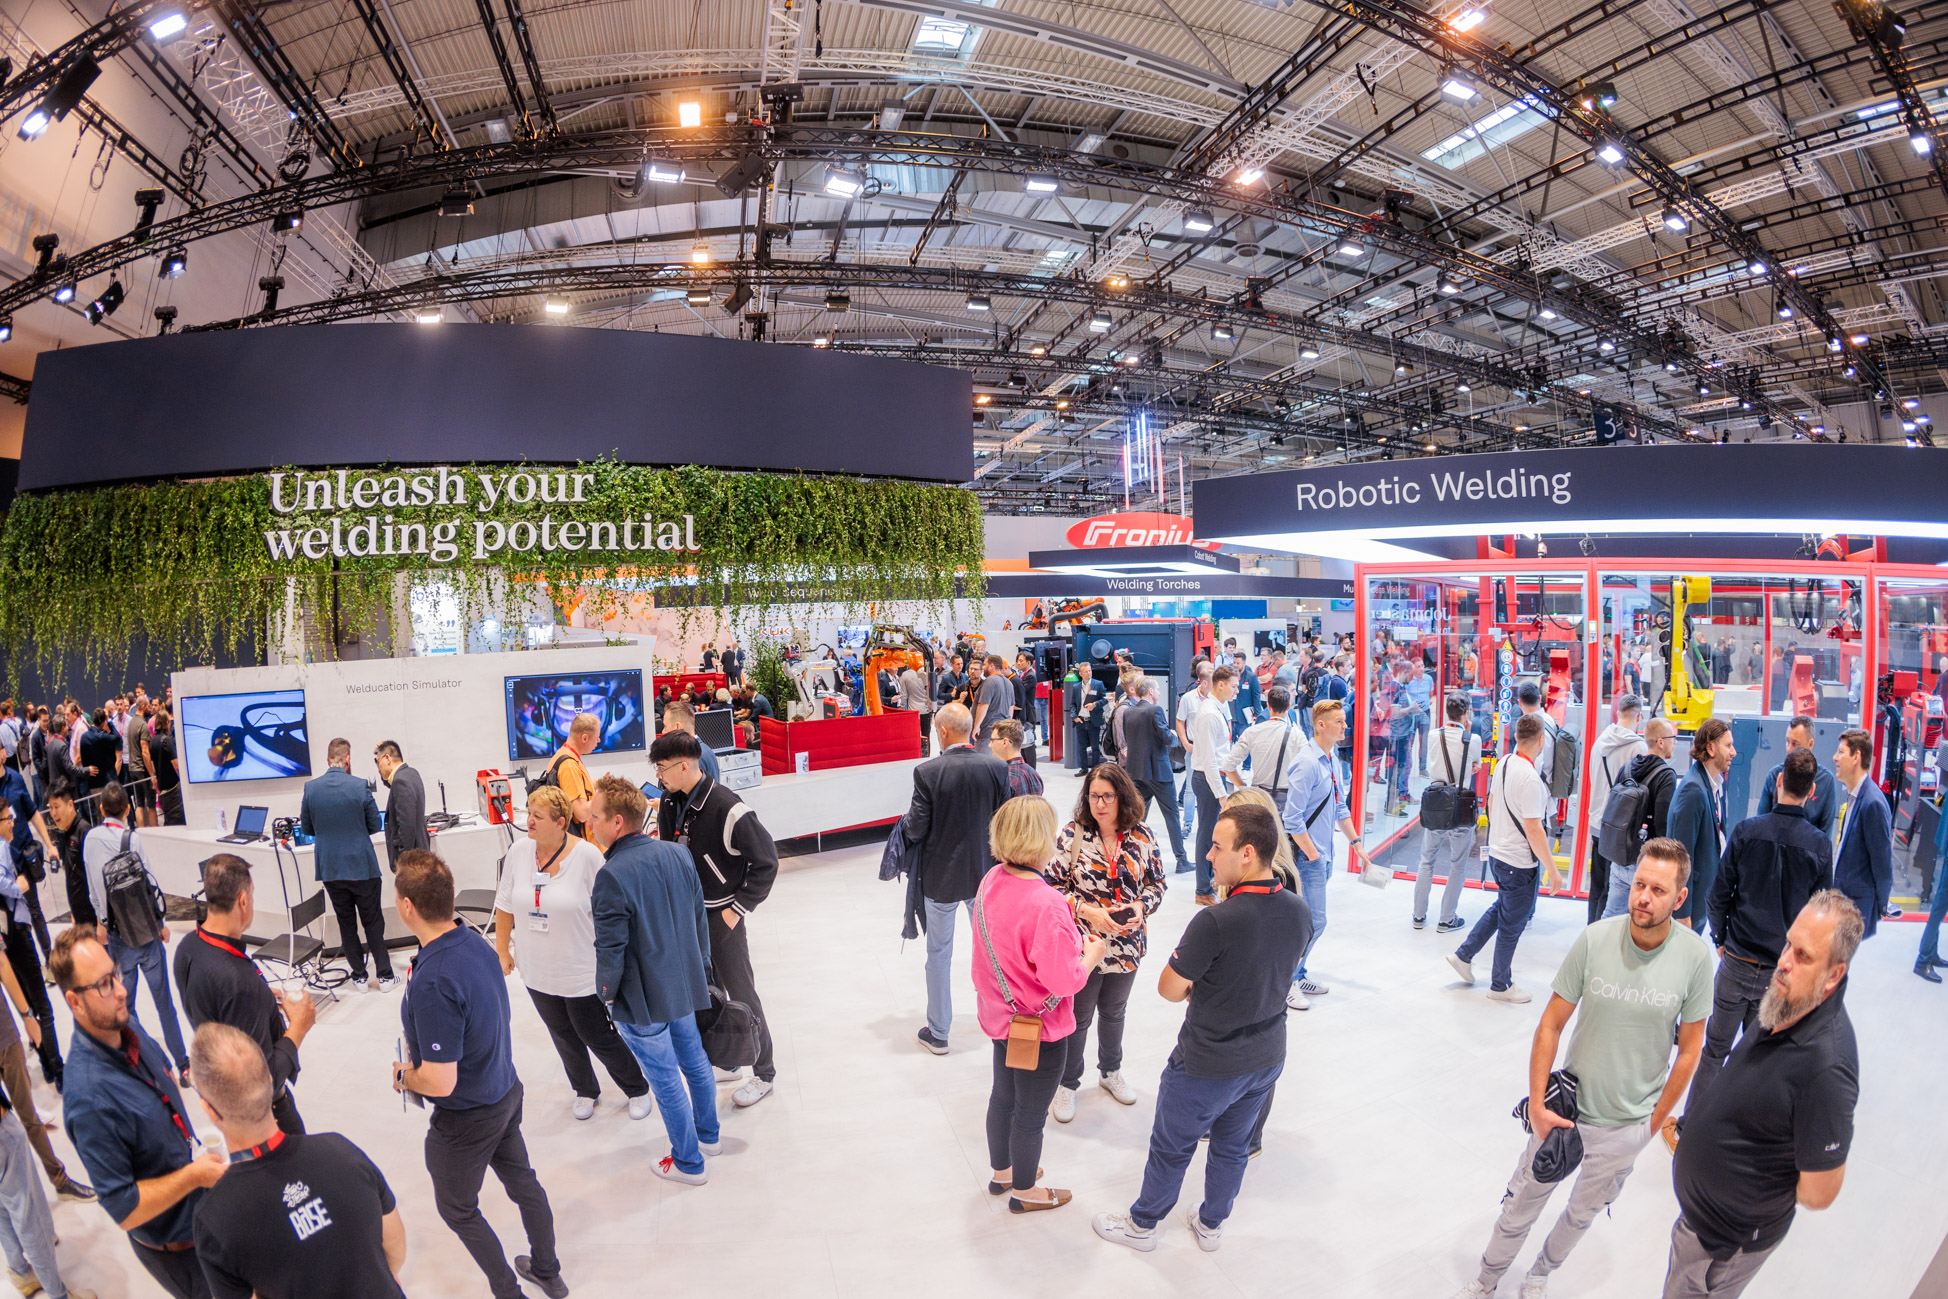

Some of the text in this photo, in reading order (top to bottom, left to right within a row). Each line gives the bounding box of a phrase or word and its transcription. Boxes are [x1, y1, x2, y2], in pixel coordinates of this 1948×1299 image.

[270, 466, 595, 513] Unleash your
[1296, 467, 1572, 511] Robotic Welding
[263, 512, 702, 562] welding potential
[1106, 578, 1201, 591] Welding Torches
[345, 679, 463, 694] Welducation Simulator
[1589, 976, 1679, 1008] Calvin Klein
